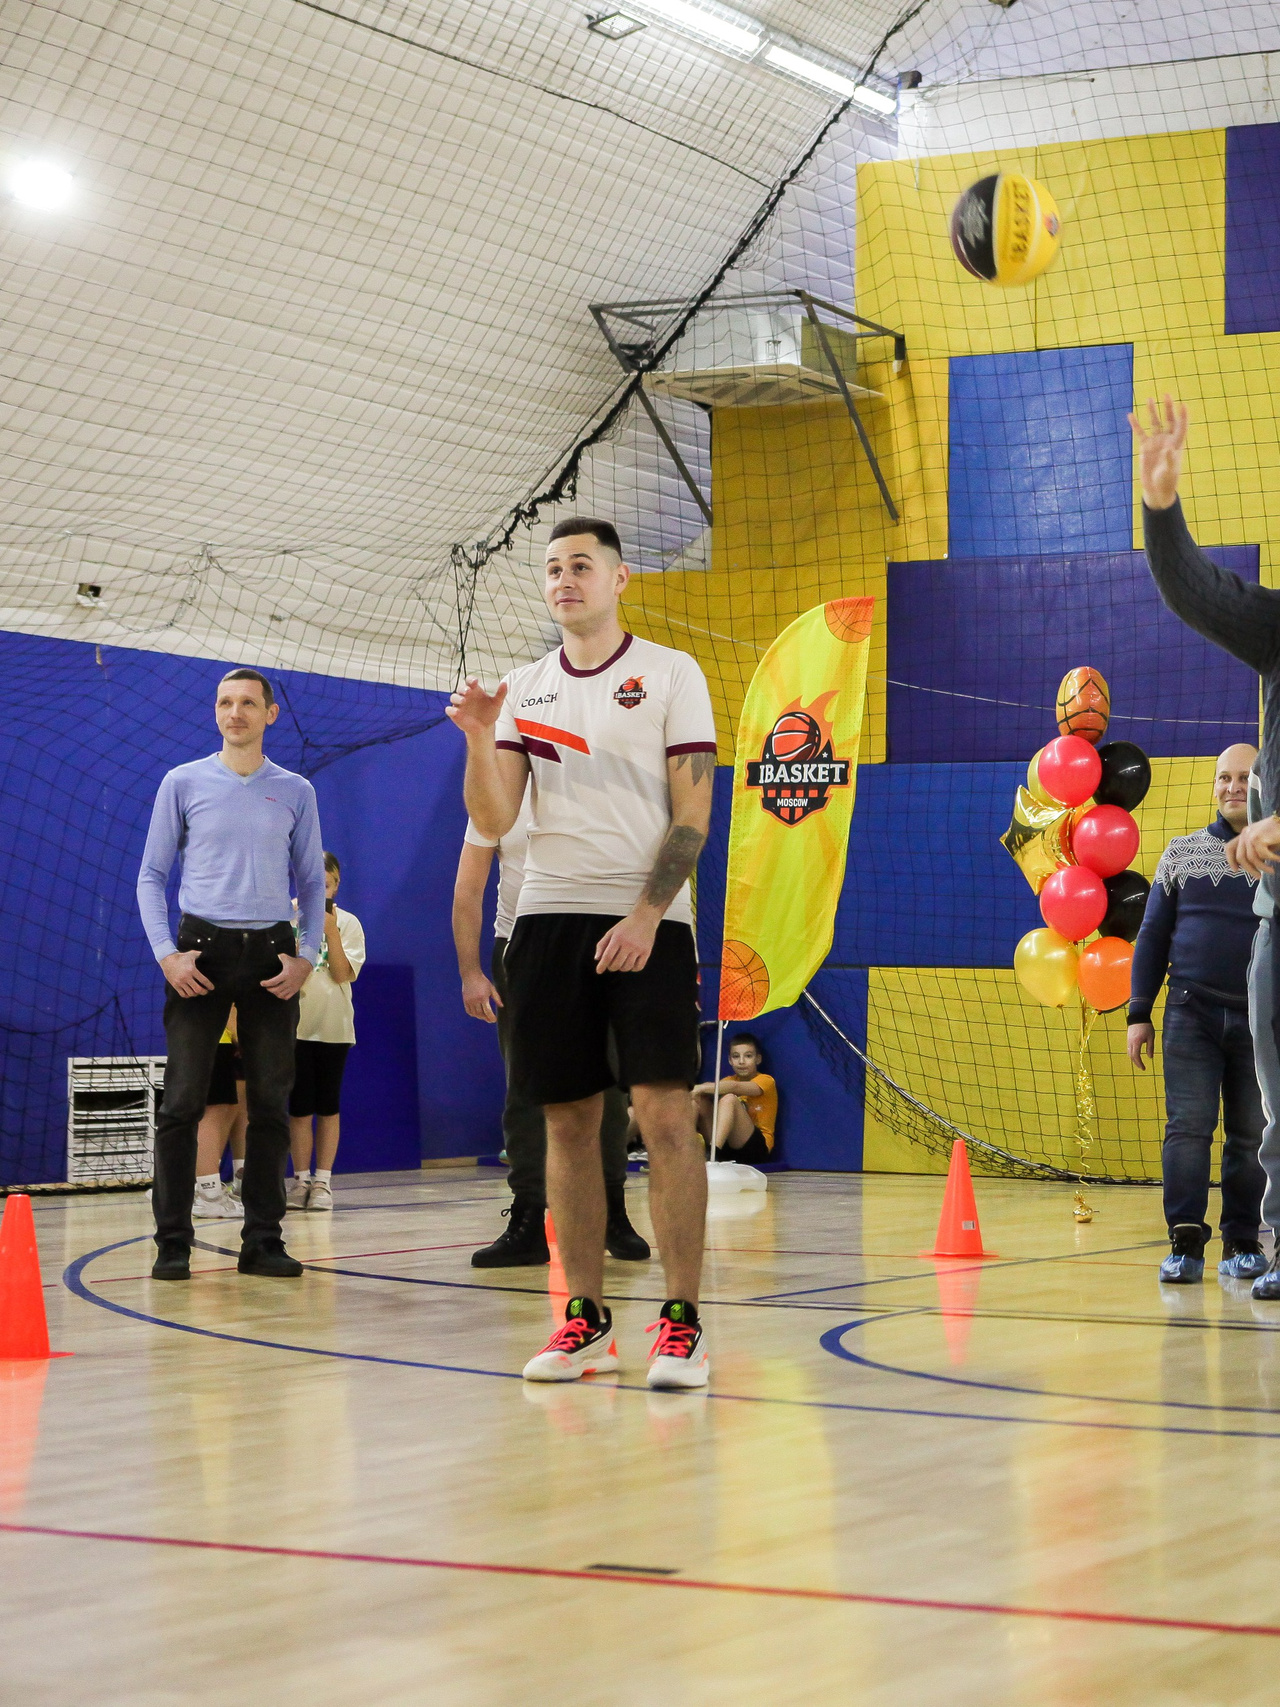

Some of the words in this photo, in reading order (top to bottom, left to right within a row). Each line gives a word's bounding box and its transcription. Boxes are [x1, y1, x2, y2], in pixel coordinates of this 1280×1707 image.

[521, 692, 559, 708] COACH
[758, 763, 846, 784] IBASKET
[776, 798, 809, 808] MOSCOW
